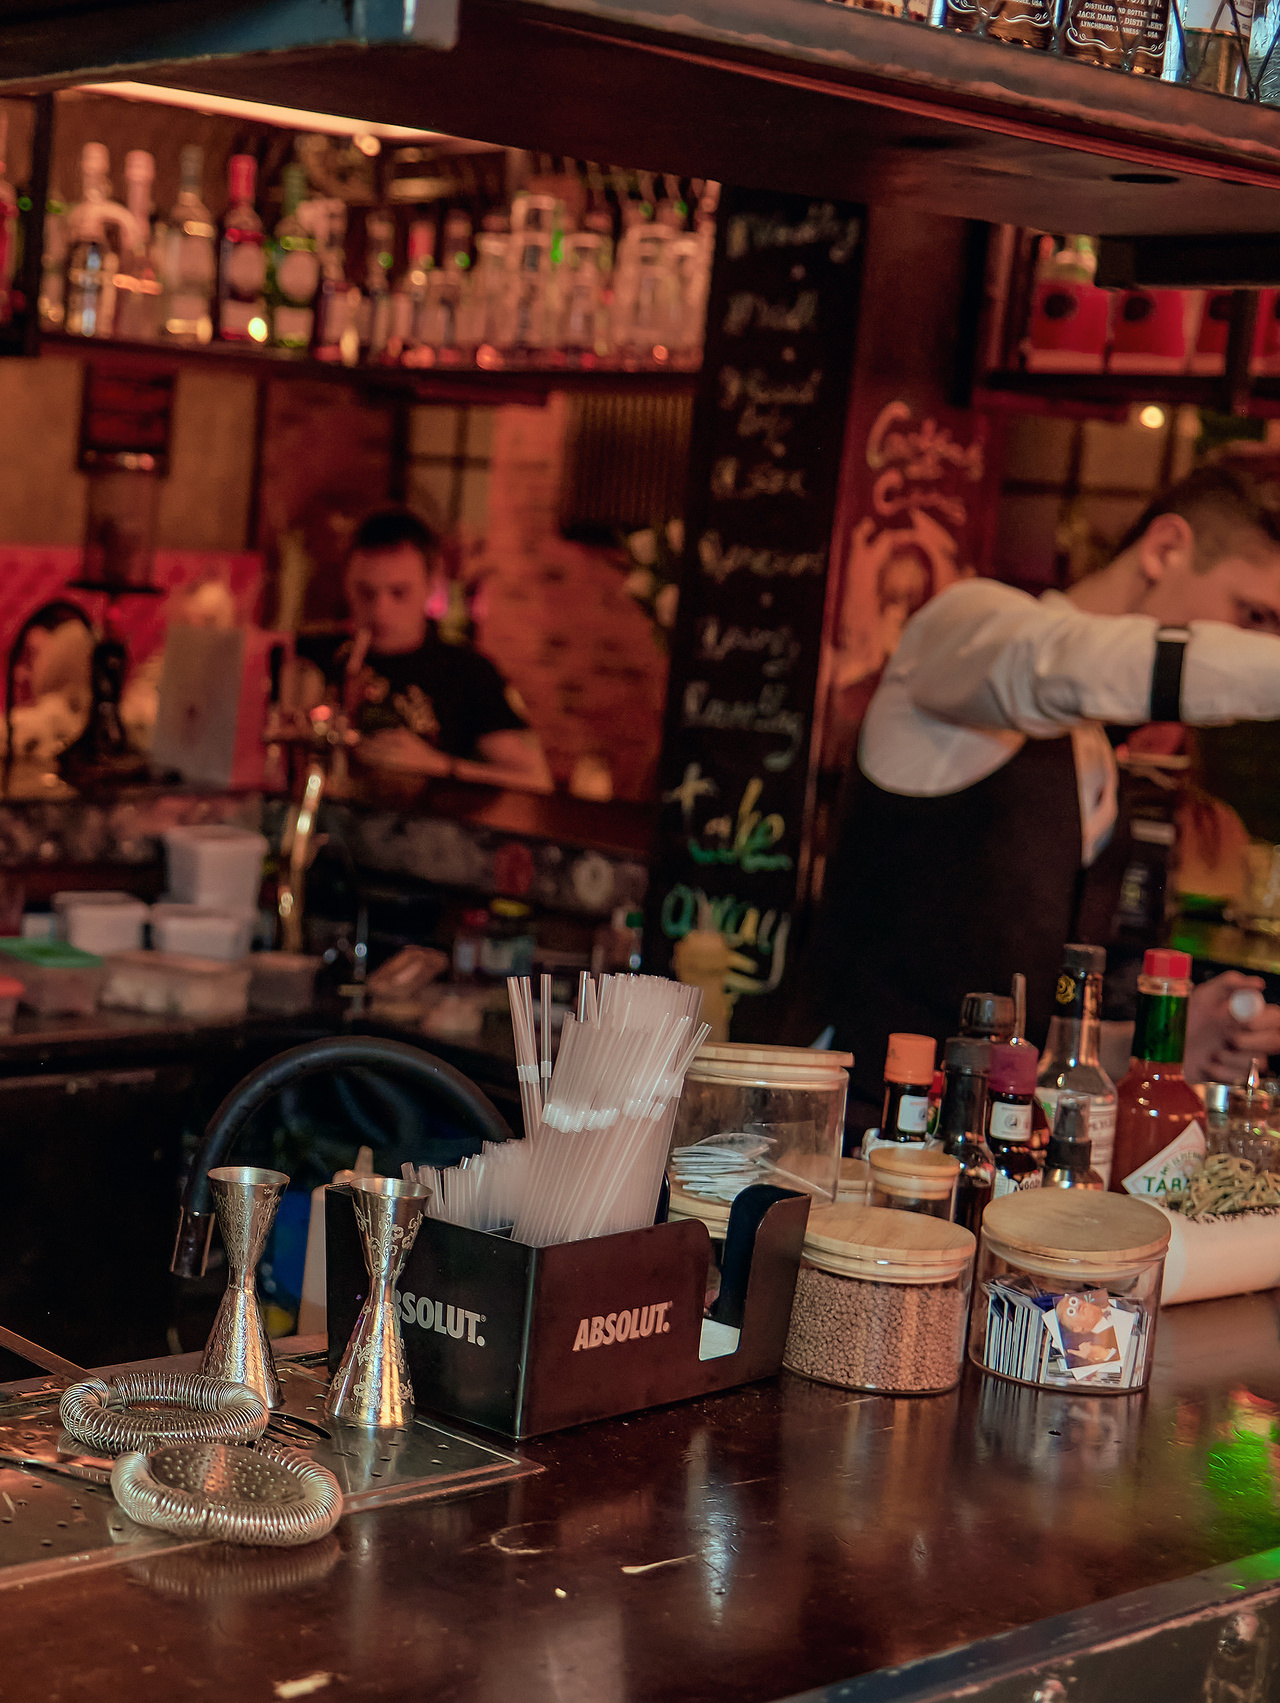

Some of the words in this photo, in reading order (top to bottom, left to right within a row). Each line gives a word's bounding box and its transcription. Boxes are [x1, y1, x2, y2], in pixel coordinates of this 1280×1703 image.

[1076, 10, 1096, 19] JACK
[1084, 2, 1114, 12] DISTILLED
[1127, 8, 1150, 18] BOTTLE
[664, 763, 792, 873] take
